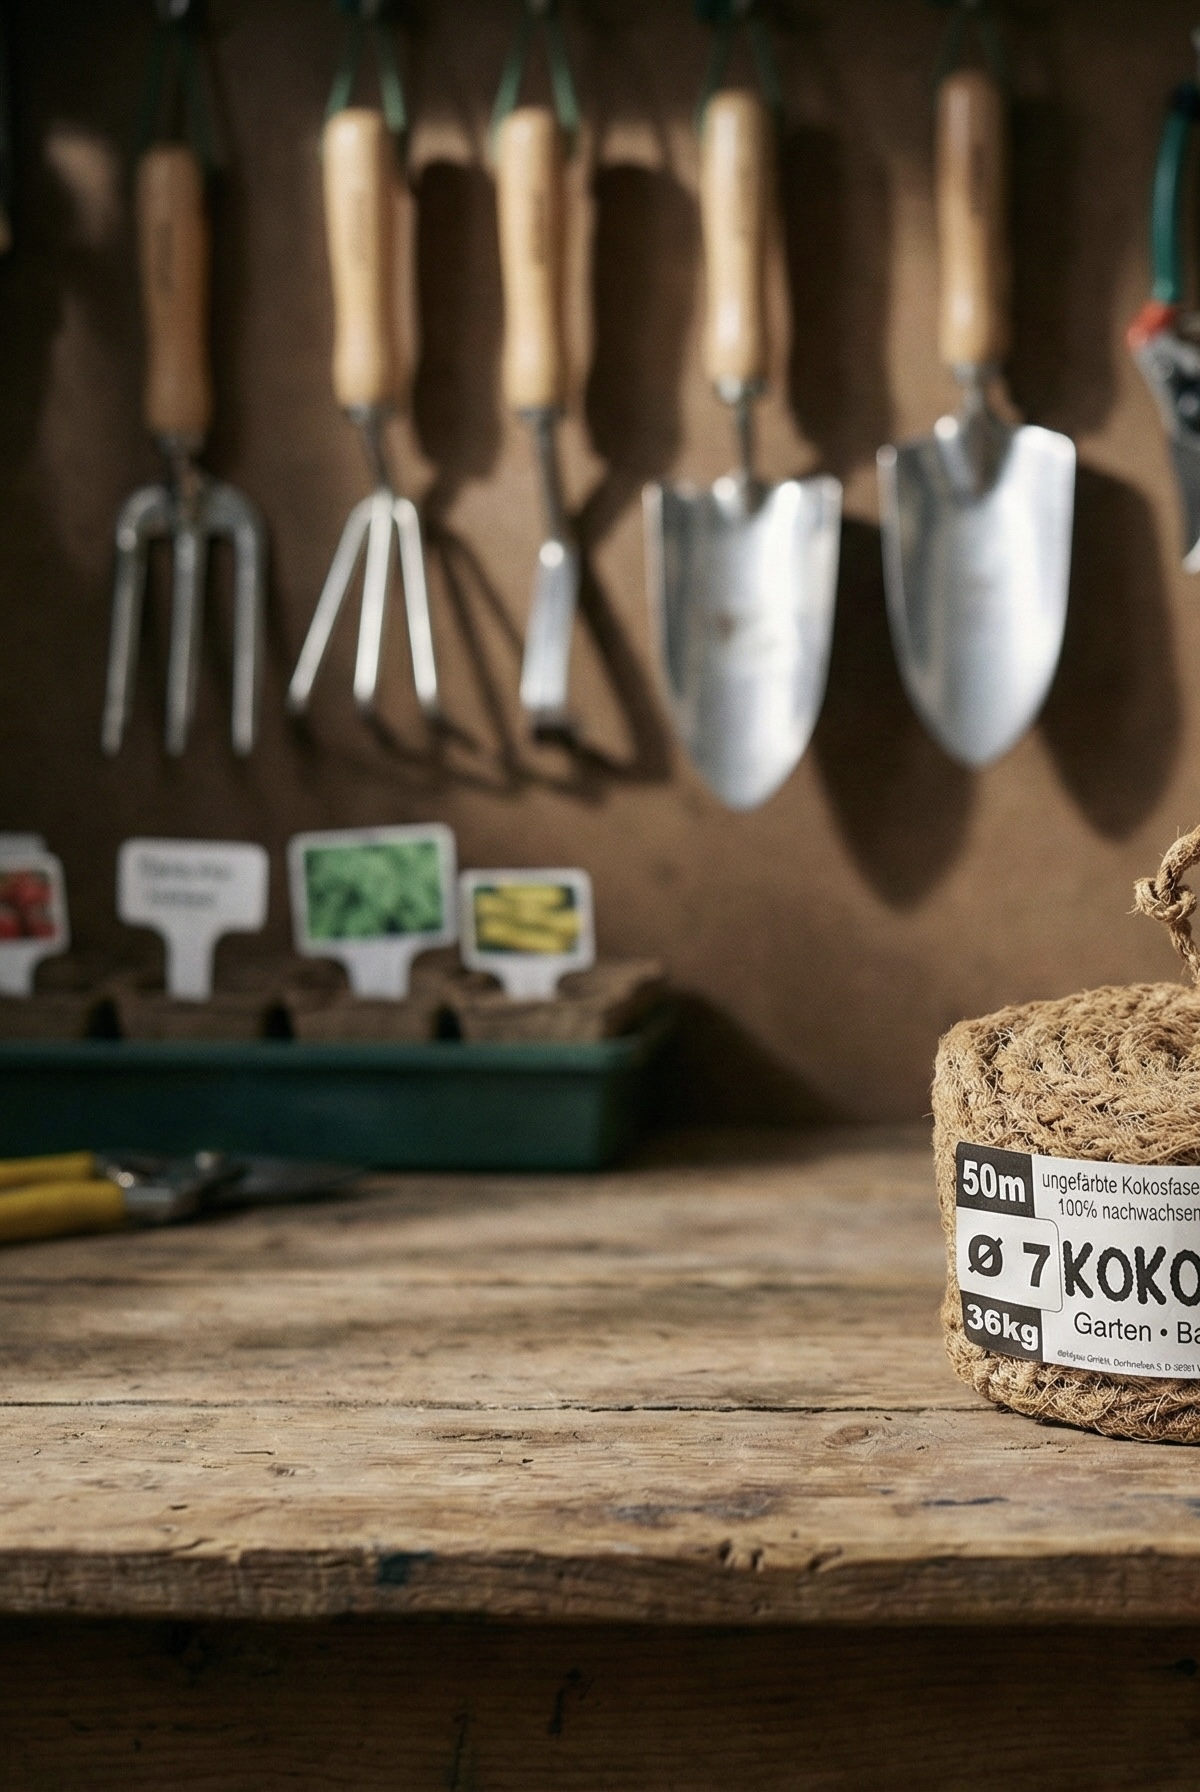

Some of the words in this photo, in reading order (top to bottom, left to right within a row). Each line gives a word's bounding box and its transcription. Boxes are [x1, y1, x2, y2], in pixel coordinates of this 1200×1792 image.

[962, 1158, 1027, 1204] 50m
[1042, 1172, 1118, 1195] ungefärbte
[1058, 1197, 1098, 1219] 100%
[1022, 1241, 1051, 1289] 7
[966, 1302, 1040, 1352] 36kg
[1073, 1311, 1152, 1343] Garten
